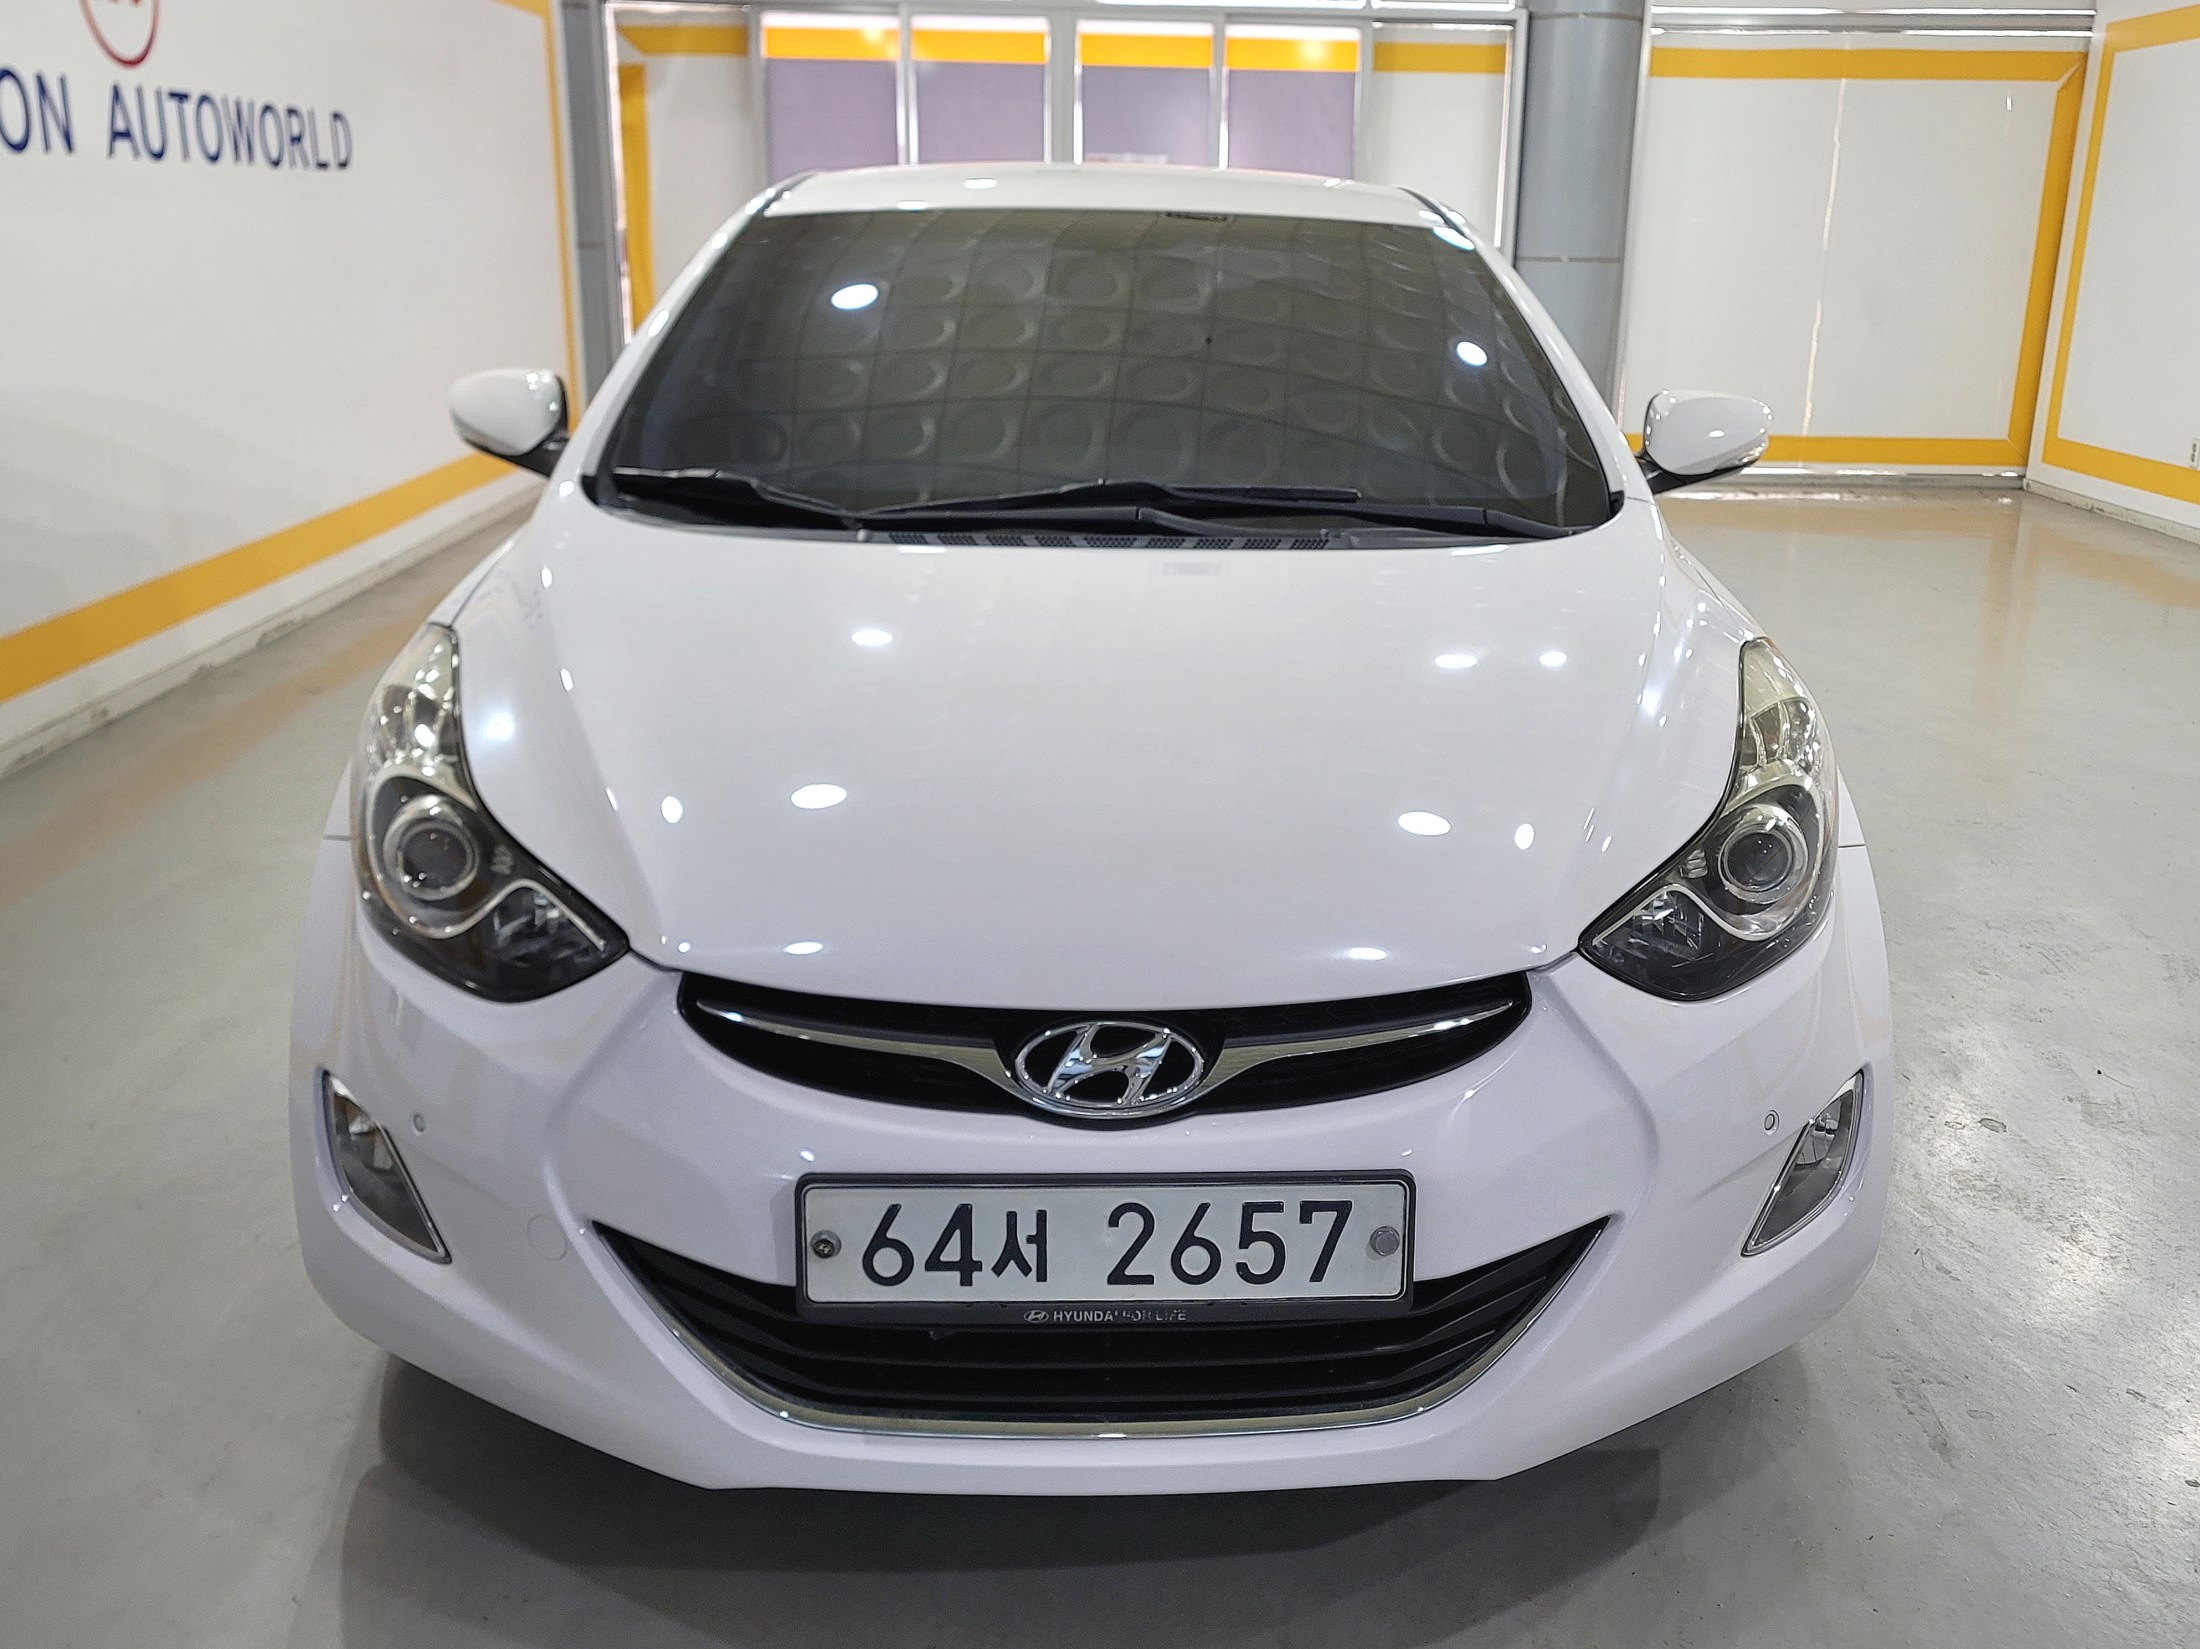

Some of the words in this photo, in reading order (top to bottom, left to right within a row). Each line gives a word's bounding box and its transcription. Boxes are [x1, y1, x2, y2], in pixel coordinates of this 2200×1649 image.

[0, 67, 75, 154] ON
[107, 83, 353, 171] AUTOWORLD
[861, 1203, 1049, 1287] 64서
[1107, 1201, 1354, 1286] 2657
